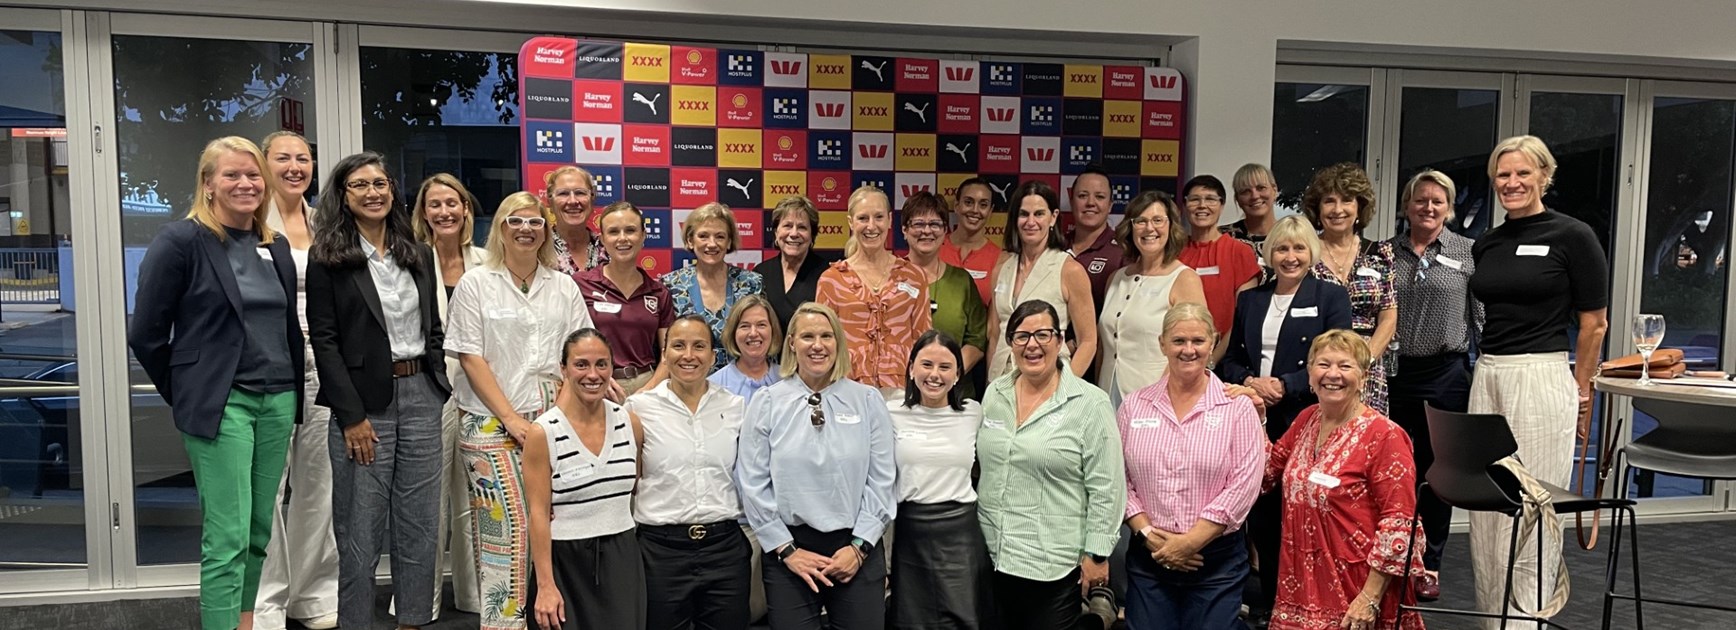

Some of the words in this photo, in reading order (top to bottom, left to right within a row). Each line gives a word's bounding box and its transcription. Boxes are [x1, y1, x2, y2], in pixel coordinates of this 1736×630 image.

[537, 47, 564, 57] Harvey
[534, 55, 564, 64] Norman
[632, 56, 663, 67] XXXX
[816, 64, 845, 74] XXXX
[905, 64, 928, 73] Harvey
[904, 72, 930, 80] Norman
[1070, 73, 1096, 83] XXXX
[1112, 72, 1135, 81] Harvey
[1111, 79, 1135, 87] Norman
[584, 92, 611, 102] Harvey
[583, 100, 612, 109] Norman
[678, 100, 709, 110] XXXX
[859, 106, 888, 116] XXXX
[947, 105, 970, 115] Harvey
[946, 113, 971, 121] Norman
[1109, 114, 1135, 123] XXXX
[1151, 112, 1173, 121] Harvey
[1149, 119, 1173, 127] Norman
[633, 136, 659, 146] Harvey
[632, 144, 660, 153] Norman
[725, 143, 755, 153] XXXX
[902, 147, 929, 157] XXXX
[988, 146, 1011, 154] Harvey
[987, 153, 1012, 161] Norman
[1147, 153, 1172, 163] XXXX
[681, 179, 707, 189] Harvey
[679, 187, 708, 195] Norman
[770, 184, 799, 194] XXXX
[737, 222, 752, 230] rvey
[984, 226, 1004, 235] XXX
